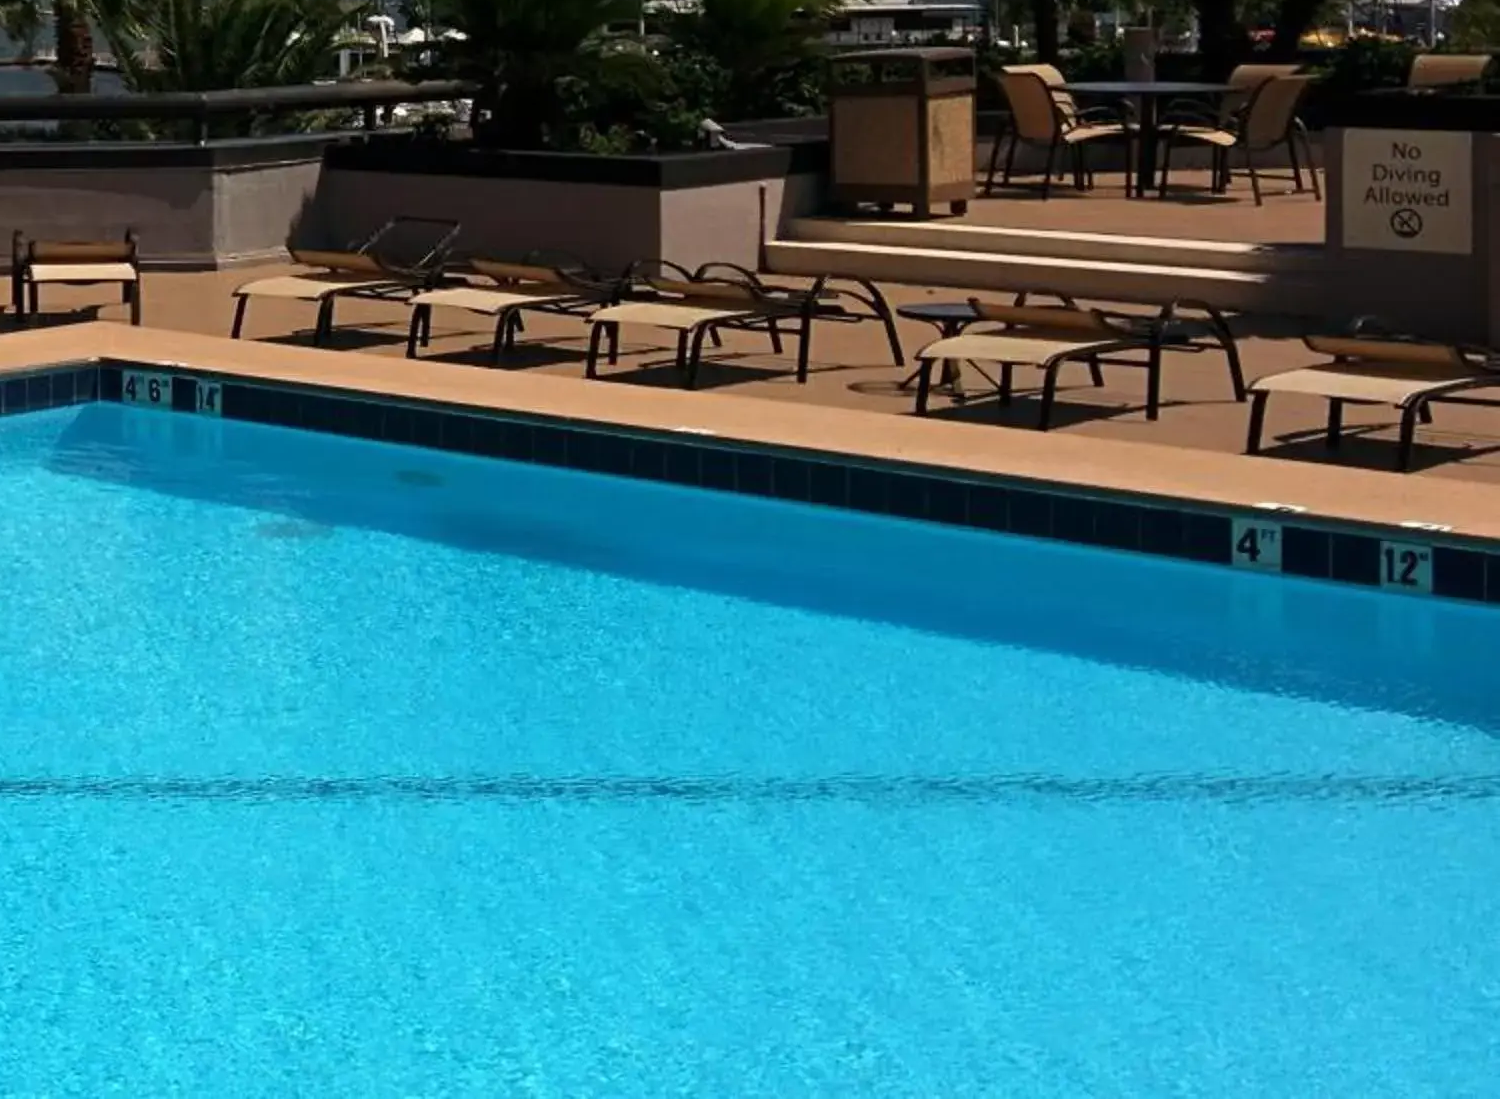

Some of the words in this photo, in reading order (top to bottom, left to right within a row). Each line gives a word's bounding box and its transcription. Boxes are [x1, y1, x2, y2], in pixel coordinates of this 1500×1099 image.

[1392, 142, 1422, 160] No
[1372, 163, 1442, 188] Diving
[1363, 186, 1450, 208] Allowed
[125, 375, 137, 402] 4
[148, 378, 161, 404] 6
